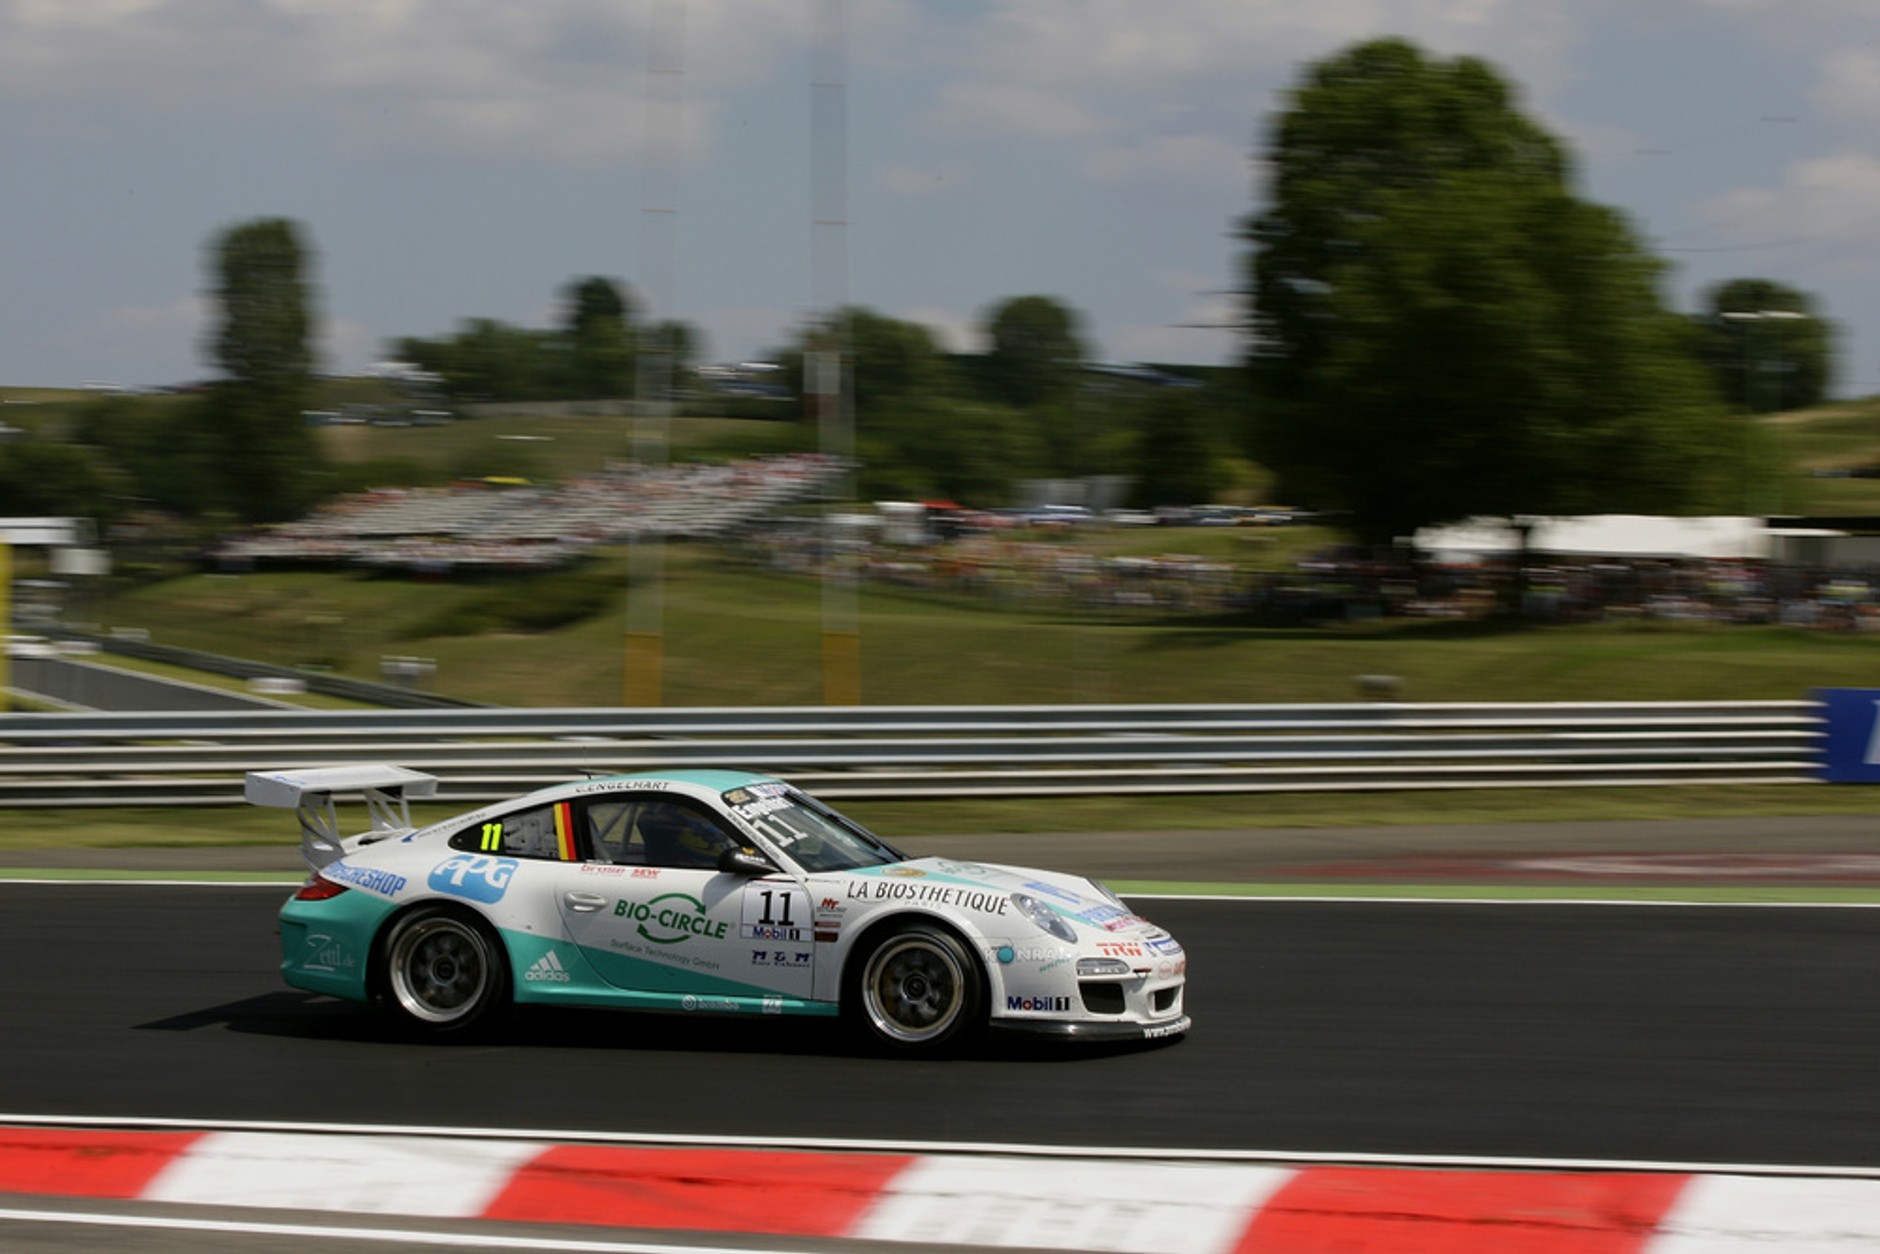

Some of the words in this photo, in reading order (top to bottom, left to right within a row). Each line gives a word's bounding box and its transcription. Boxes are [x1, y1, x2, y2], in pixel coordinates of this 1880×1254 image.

[481, 824, 502, 851] 11
[434, 855, 515, 888] PPG
[758, 890, 794, 926] 11
[847, 881, 868, 898] LA
[876, 882, 1010, 916] BIOSTHETIQUE
[613, 899, 728, 939] BIO-CIRCLE
[753, 926, 786, 940] Mobil
[790, 928, 800, 940] 1
[610, 939, 642, 952] Surface
[645, 946, 691, 964] Technology
[692, 957, 719, 970] GmbH
[752, 950, 766, 960] M
[796, 953, 810, 962] M
[1096, 942, 1142, 956] TRW
[525, 965, 570, 982] adidas
[1007, 996, 1052, 1011] Mobil
[1055, 997, 1069, 1011] 1
